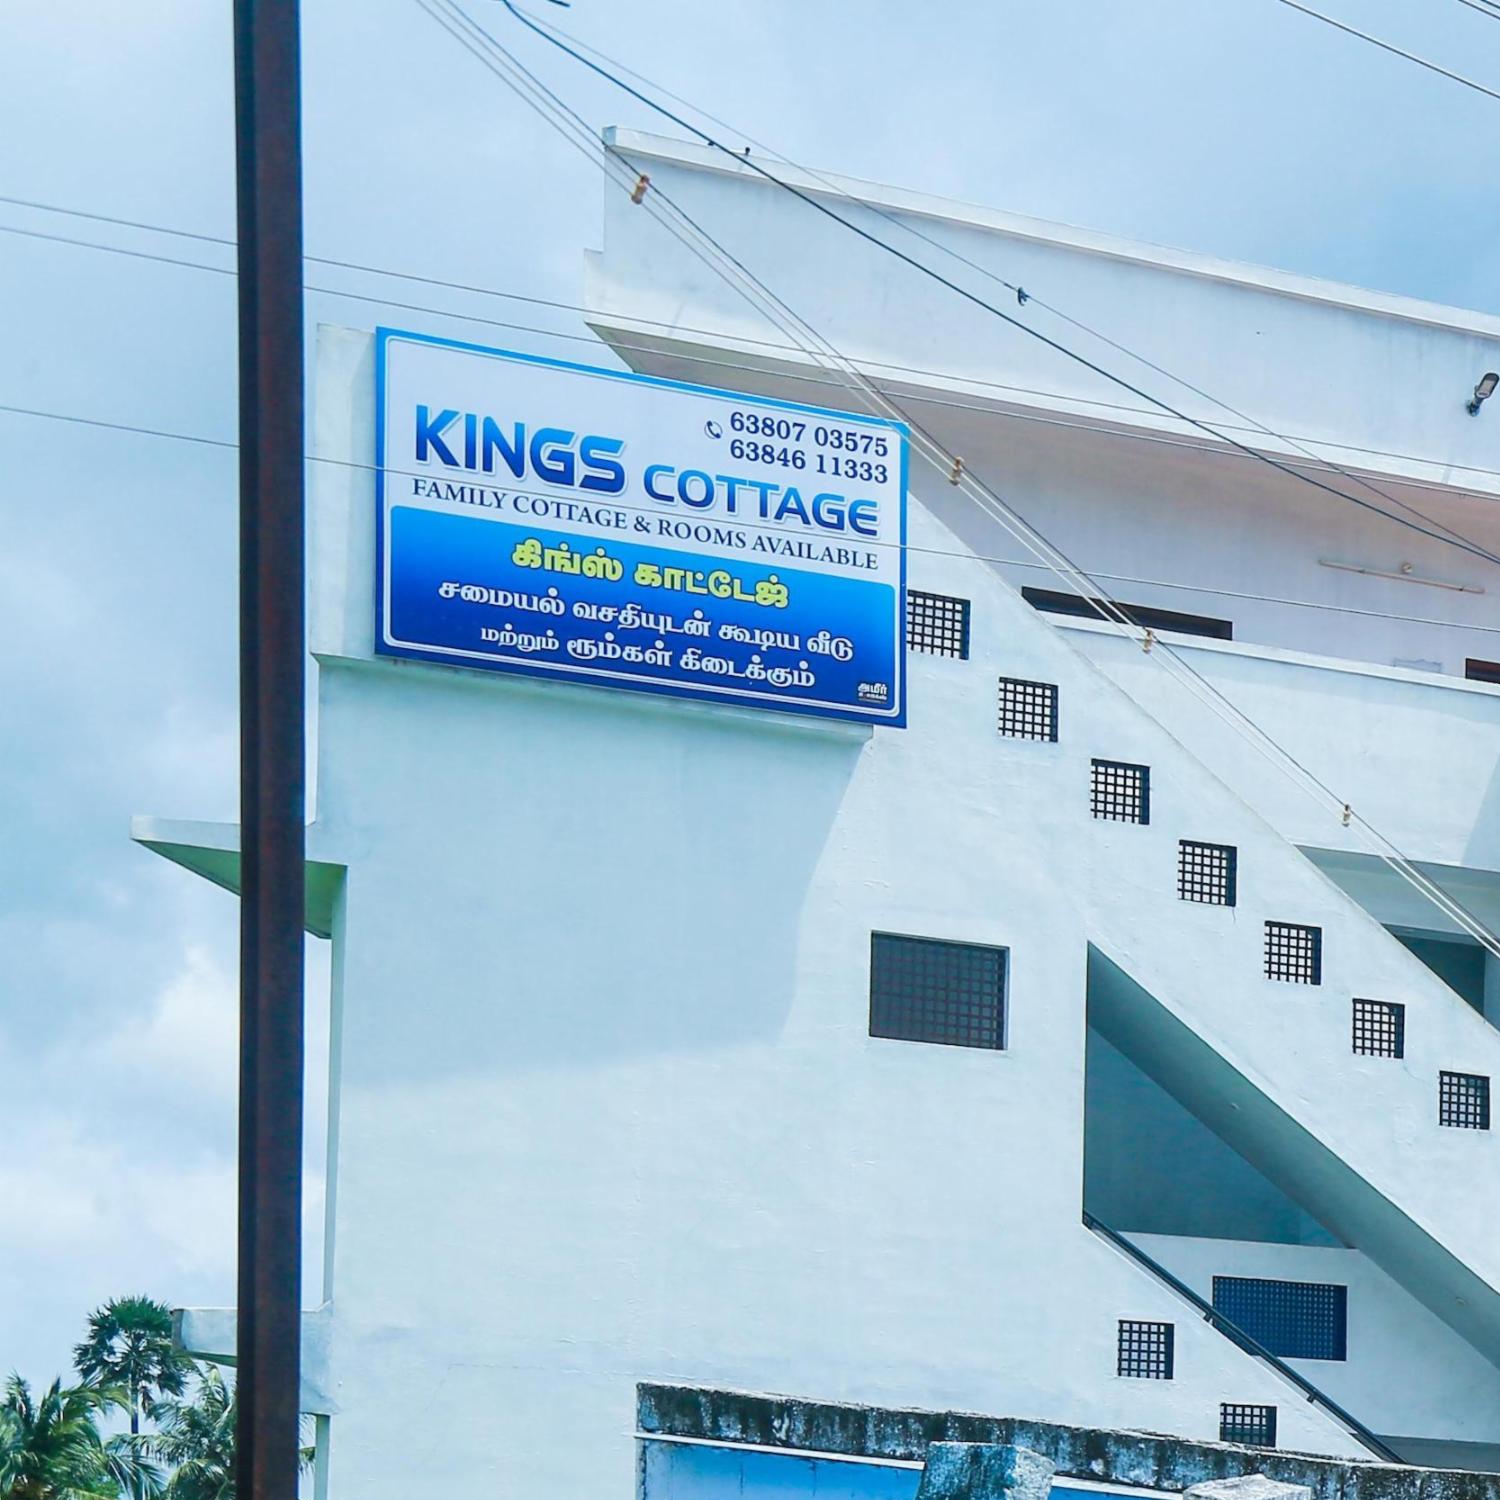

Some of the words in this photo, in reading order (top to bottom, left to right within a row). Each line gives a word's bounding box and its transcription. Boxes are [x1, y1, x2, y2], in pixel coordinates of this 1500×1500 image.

[730, 411, 805, 441] 63807
[814, 426, 888, 457] 03575
[730, 440, 805, 470] 63846
[816, 454, 888, 484] 11333
[416, 404, 625, 495] KINGS
[644, 465, 878, 537] COTTAGE
[412, 479, 507, 509] FAMILY
[513, 495, 627, 530] COTTAGE
[634, 516, 650, 532] &
[657, 520, 746, 549] ROOMS
[751, 536, 878, 570] AVAILABLE
[511, 538, 623, 582] கிங்ஸ்
[634, 563, 790, 610] காட்டேஜ்
[438, 580, 565, 616] சமையல்
[572, 601, 711, 640] வசதியுடன்
[718, 623, 800, 652] கூடிய
[806, 628, 854, 663] வீடு
[481, 624, 559, 653] மற்றும்
[566, 634, 672, 668] ரூம்கள்
[679, 649, 815, 689] கிடைக்கும்
